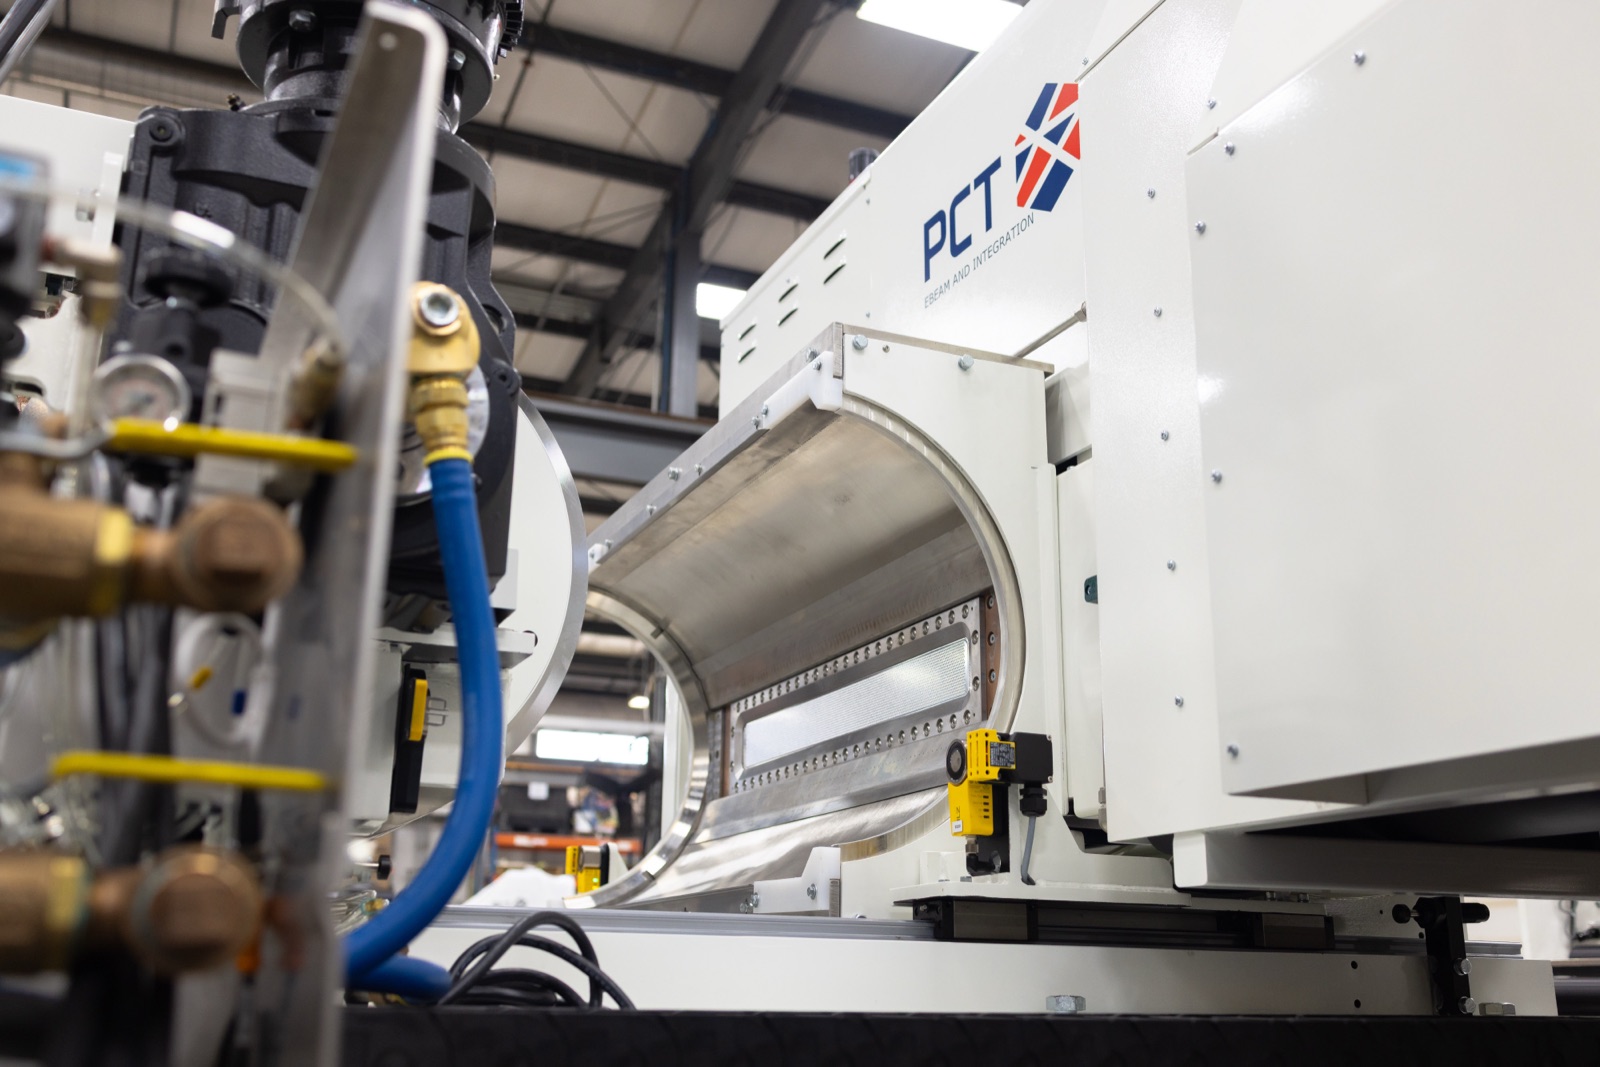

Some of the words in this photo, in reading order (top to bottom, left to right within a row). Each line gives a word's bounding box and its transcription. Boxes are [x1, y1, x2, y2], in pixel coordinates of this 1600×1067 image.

[924, 155, 1001, 283] PCT
[924, 279, 950, 308] EBEAM
[953, 264, 970, 286] AND
[973, 212, 1034, 271] INTEGRATION
